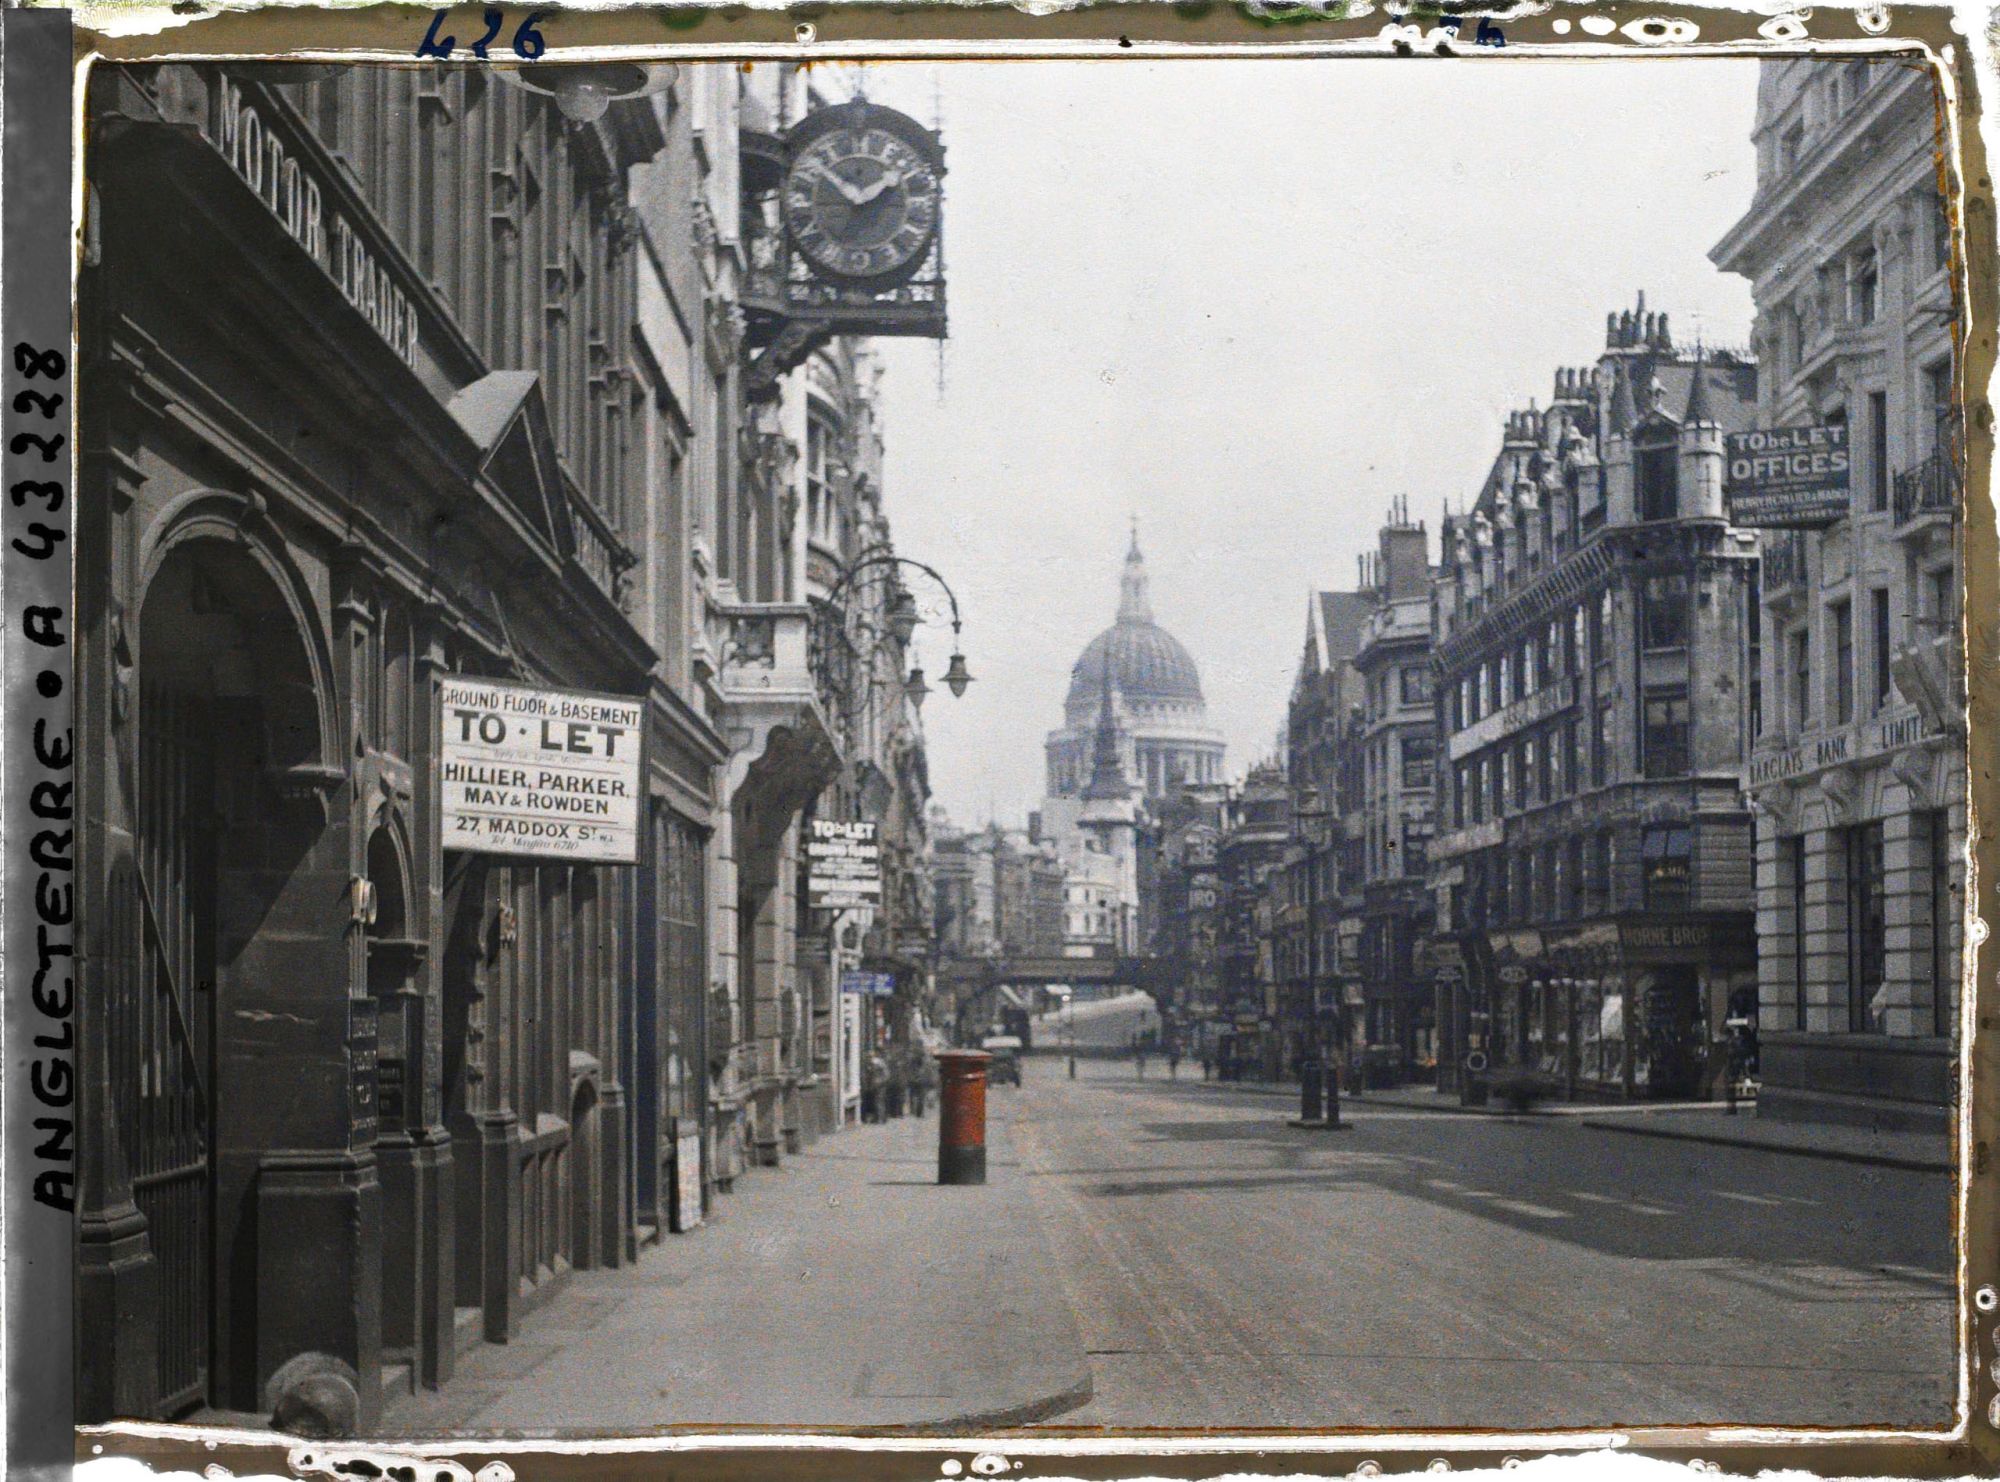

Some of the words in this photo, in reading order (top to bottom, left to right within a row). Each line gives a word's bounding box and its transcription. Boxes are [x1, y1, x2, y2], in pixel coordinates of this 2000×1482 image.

[415, 7, 545, 61] 426
[219, 71, 322, 260] MOTOR
[334, 212, 419, 369] TRADER
[10, 341, 66, 560] 43228
[1734, 433, 1766, 450] TO
[1767, 432, 1790, 448] be
[1792, 425, 1844, 446] LET
[1731, 451, 1849, 480] OFFICES
[503, 694, 547, 715] FLOOR
[550, 704, 558, 716] &
[561, 702, 639, 726] BASEMENT
[454, 710, 506, 745] TO
[541, 719, 625, 757] LET
[1750, 750, 1804, 785] BARCLAYS
[1817, 735, 1848, 765] BANK
[445, 763, 532, 790] HILLIER,
[538, 771, 630, 798] PARKER,
[465, 787, 509, 806] MAY
[510, 795, 522, 808] &
[527, 792, 609, 815] ROWDEN
[456, 815, 481, 836] 27,
[488, 818, 570, 840] MADDOX
[812, 820, 834, 838] TO
[845, 822, 876, 839] LET
[1622, 926, 1670, 947] HORNE
[29, 718, 74, 1214] ANGLETERRE
